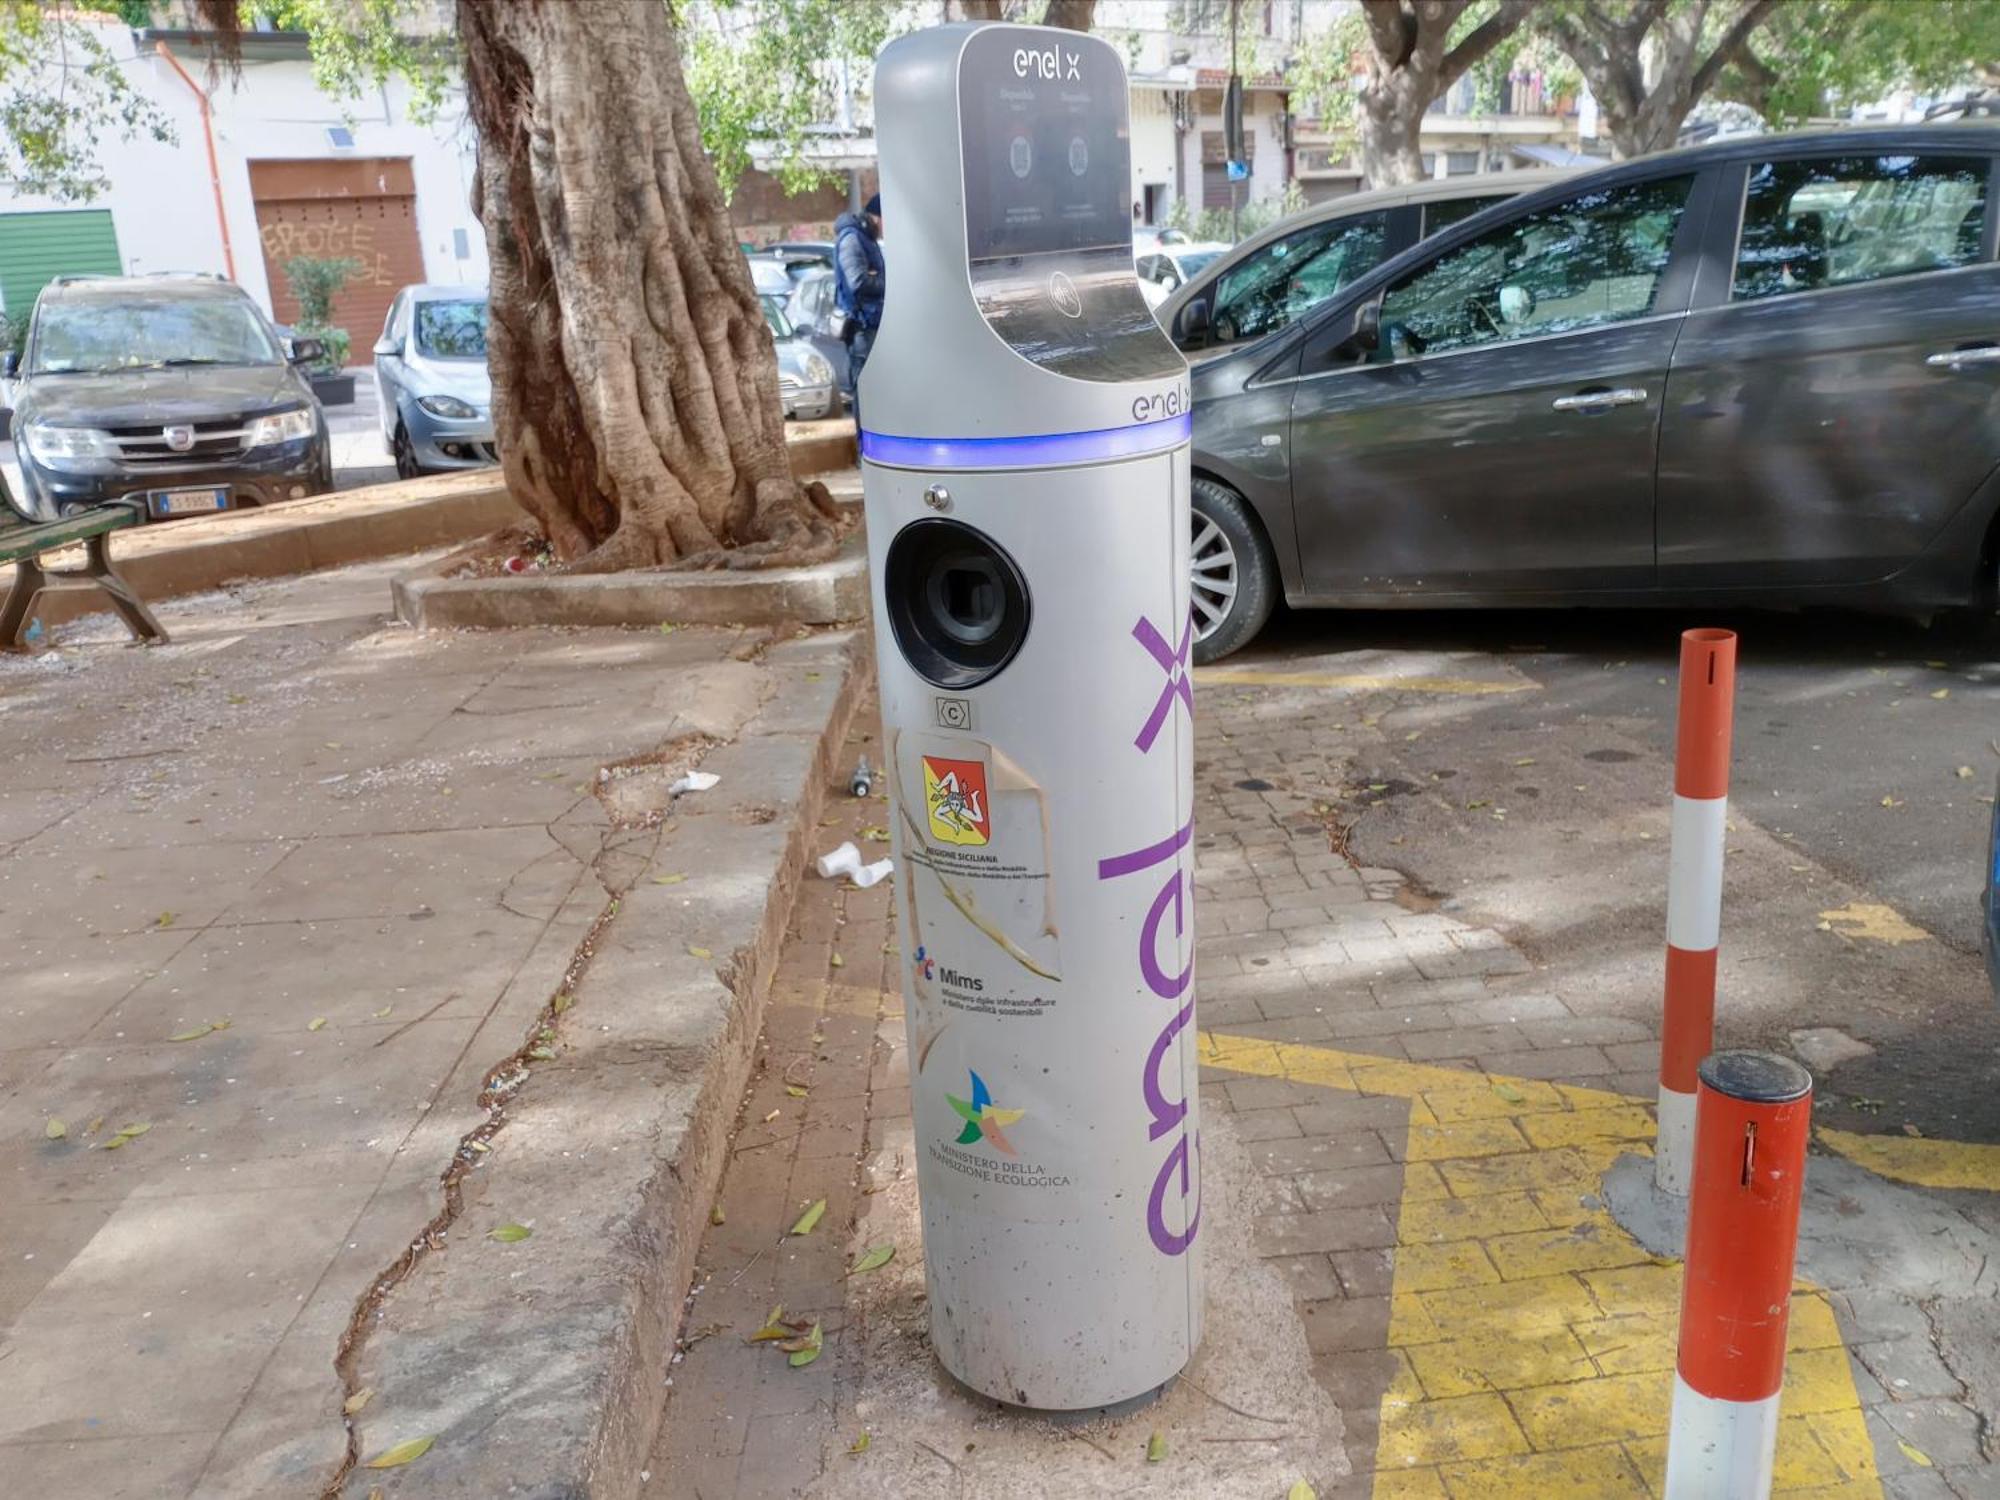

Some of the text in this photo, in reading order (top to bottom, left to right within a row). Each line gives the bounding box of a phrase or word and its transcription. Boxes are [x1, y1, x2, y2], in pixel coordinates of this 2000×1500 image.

[1013, 45, 1082, 81] enel x
[1132, 382, 1182, 421] enel
[926, 847, 957, 860] REGIONE
[958, 852, 998, 863] SICILIANA
[940, 967, 983, 991] Mims
[1098, 808, 1201, 1256] enel
[928, 1145, 1070, 1187] TRANSIZIONE ECOLOGICA
[941, 1143, 1044, 1175] MINISTERO DELLA
